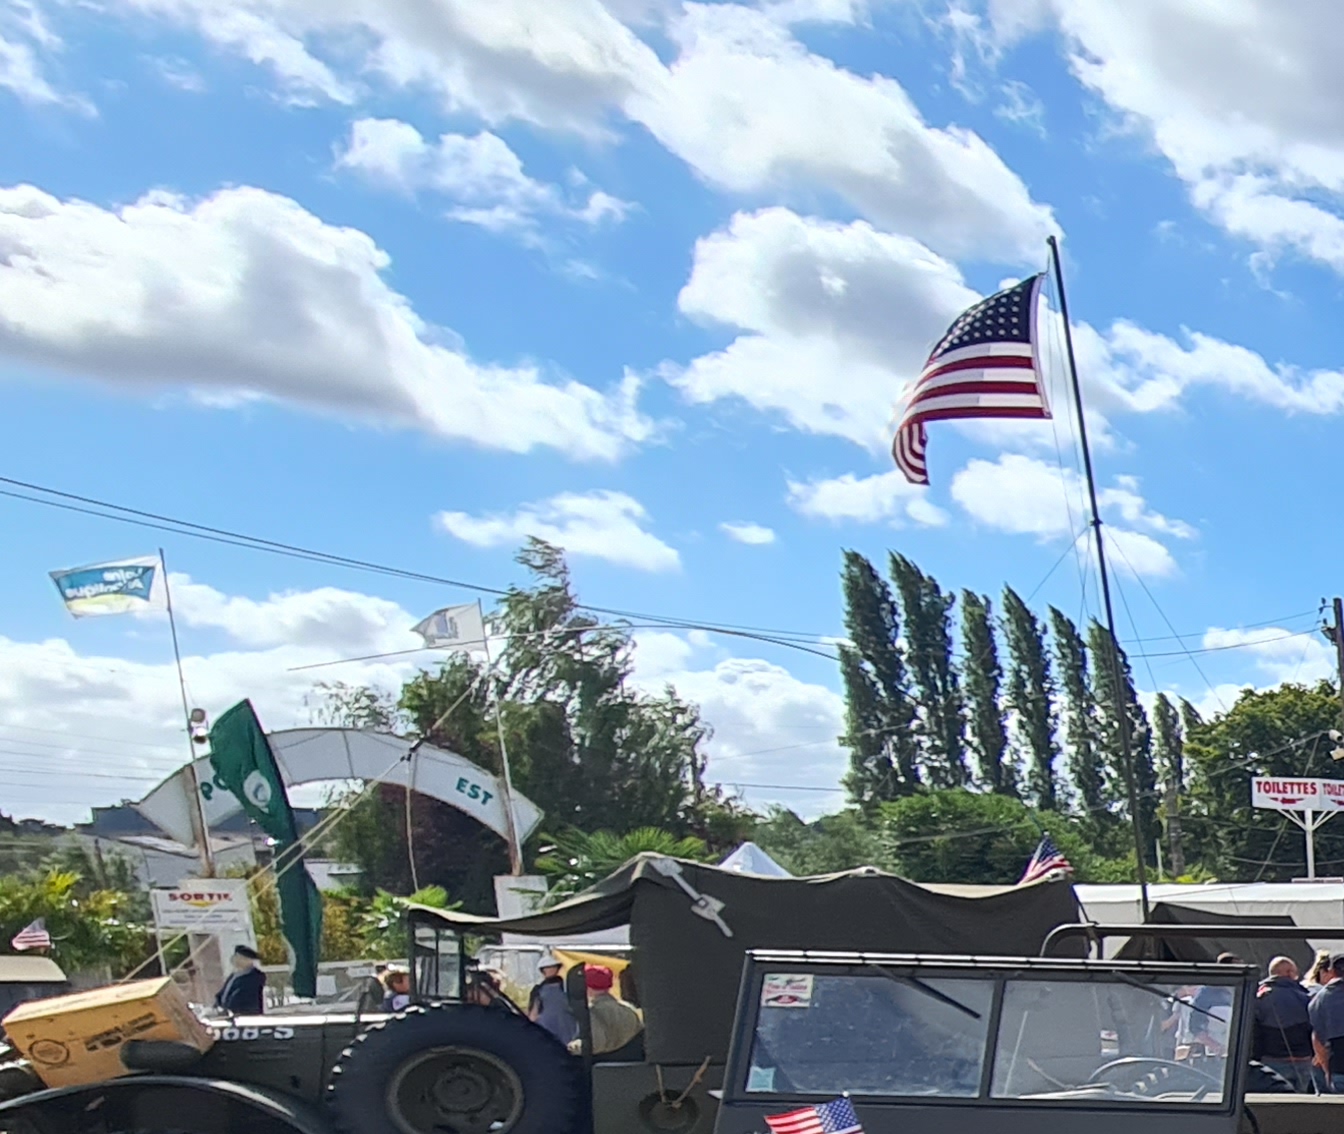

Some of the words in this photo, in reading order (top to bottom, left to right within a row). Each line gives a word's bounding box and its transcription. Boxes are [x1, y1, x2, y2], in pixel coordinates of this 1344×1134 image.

[456, 776, 494, 806] EST
[1255, 780, 1318, 795] TOILETTES
[168, 892, 233, 902] SORTIE
